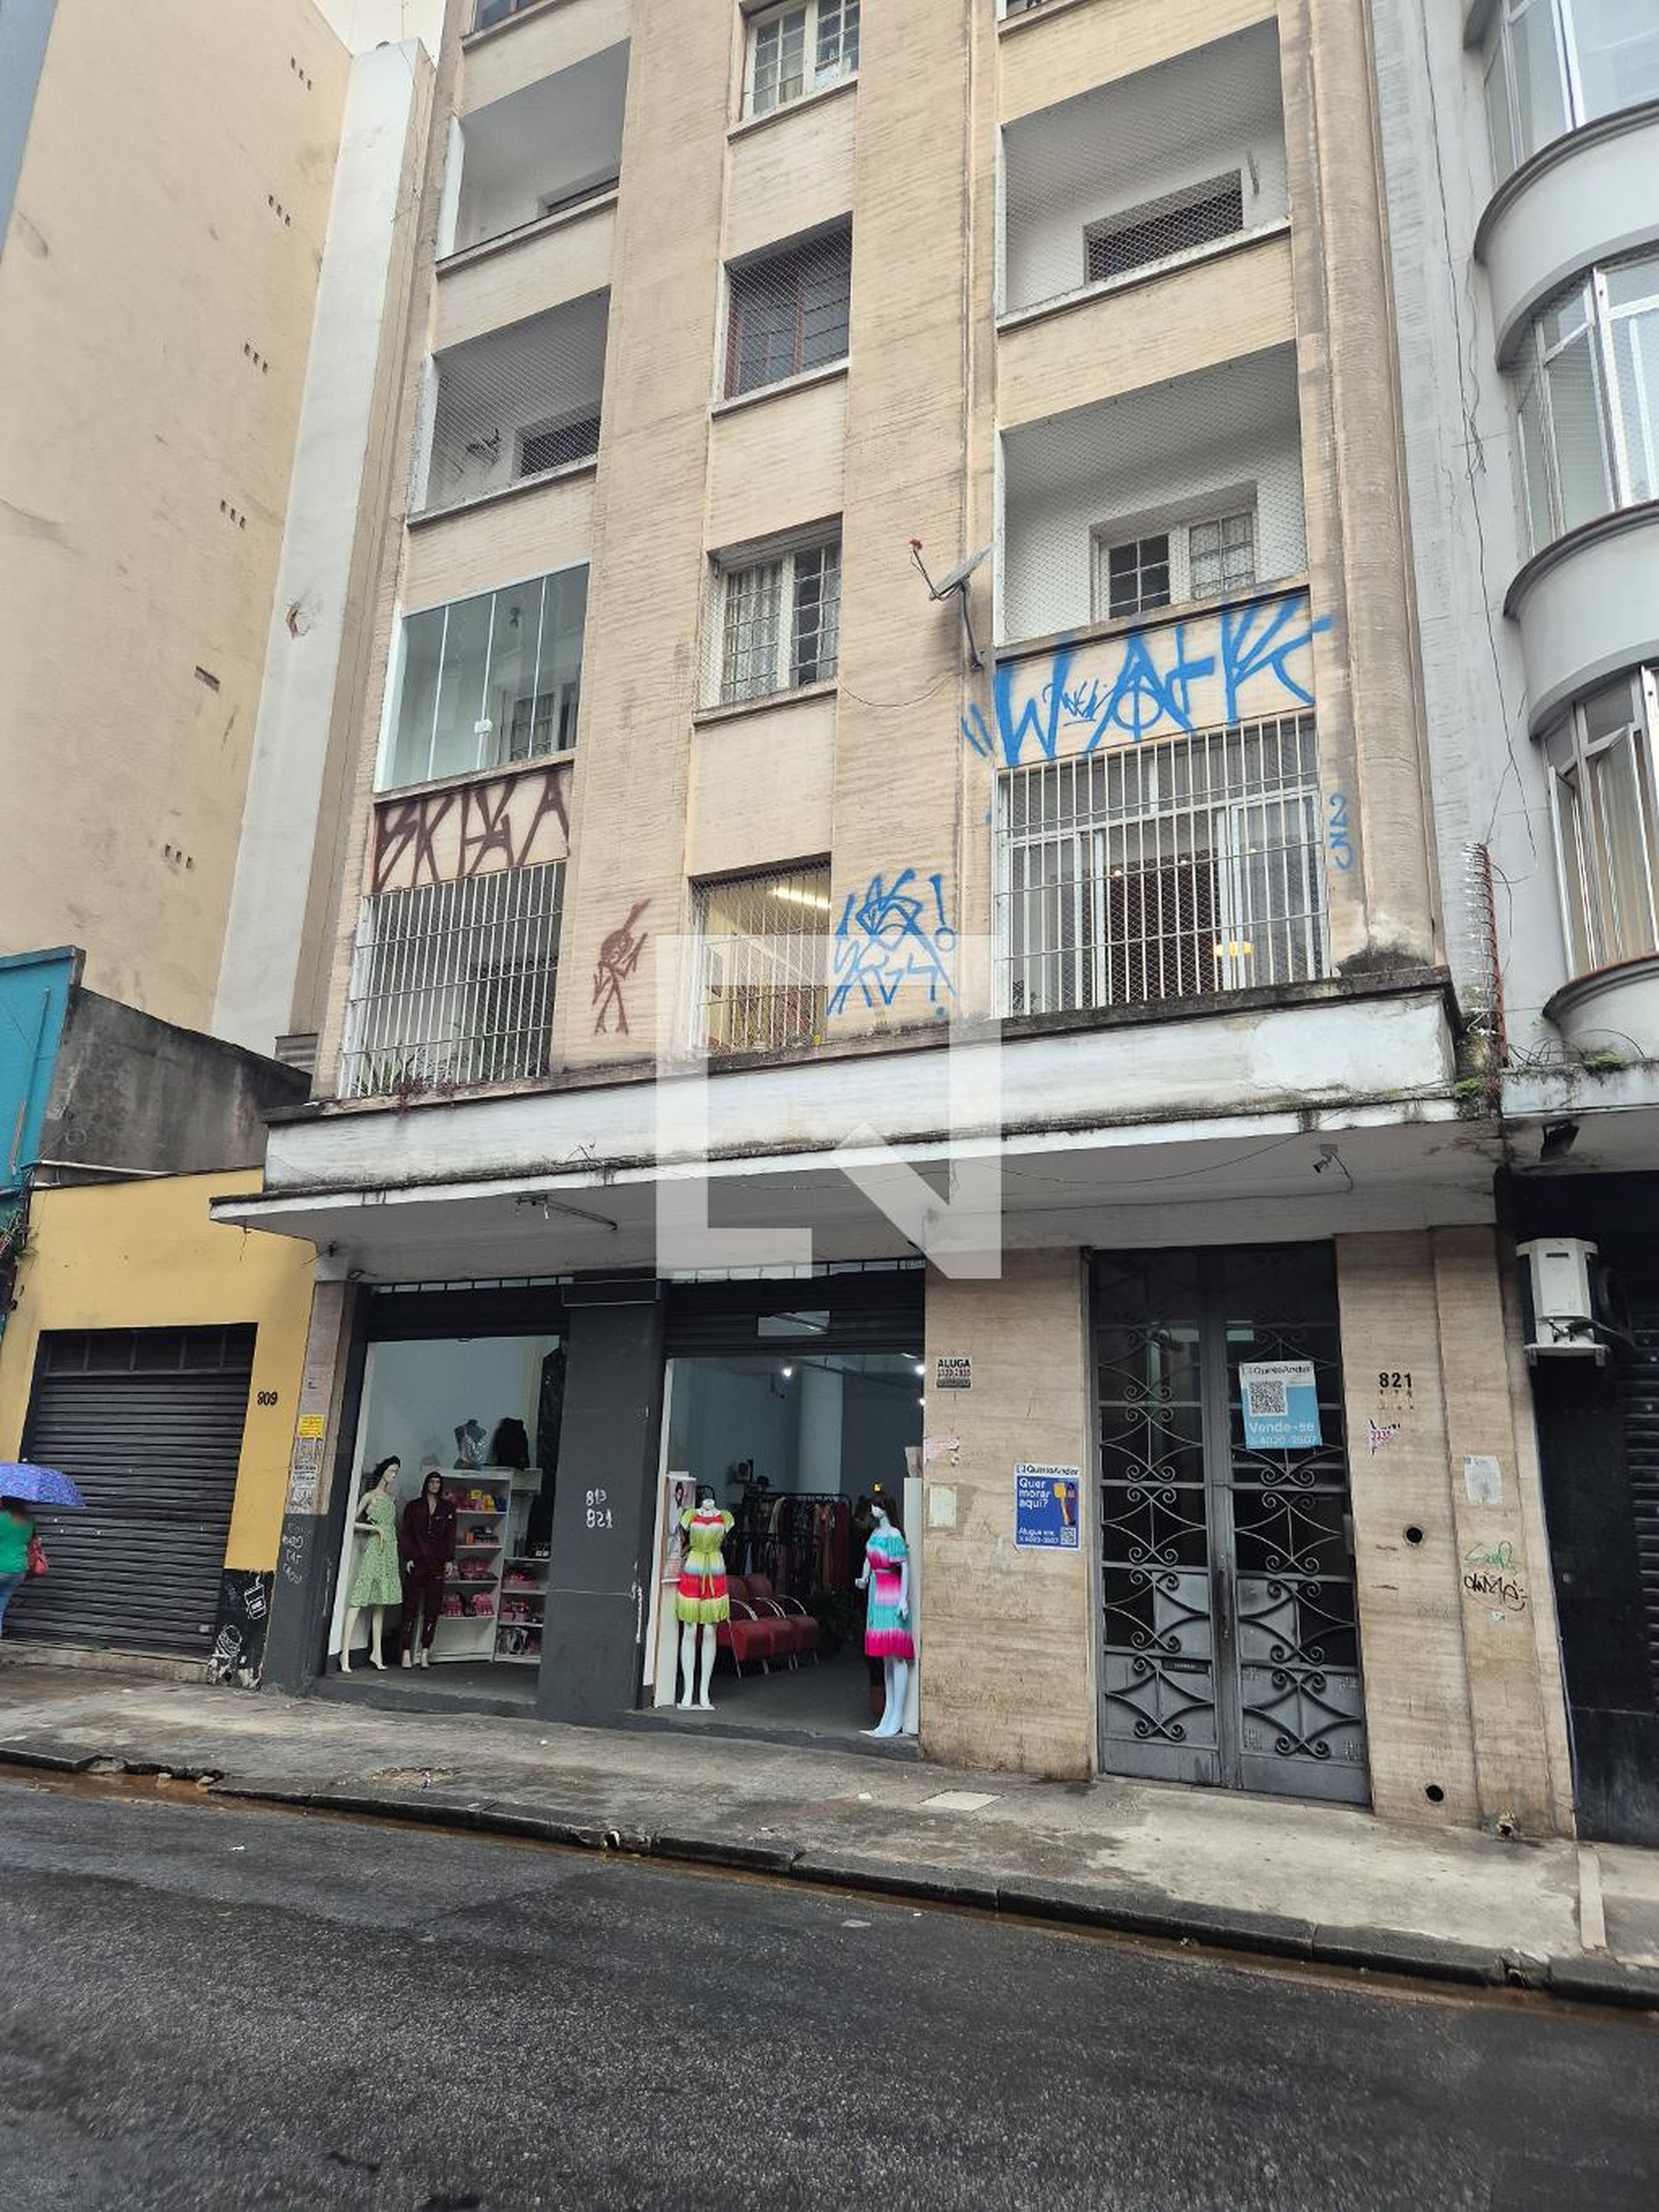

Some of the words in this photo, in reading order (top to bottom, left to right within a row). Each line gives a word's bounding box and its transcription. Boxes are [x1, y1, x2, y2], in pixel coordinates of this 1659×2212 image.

[938, 1359, 971, 1368] ALUGA
[1379, 1372, 1411, 1388] 821
[1019, 1477, 1046, 1489] Quer
[1019, 1489, 1052, 1498] morar
[1019, 1499, 1049, 1510] aqui?
[586, 1509, 613, 1528] 821
